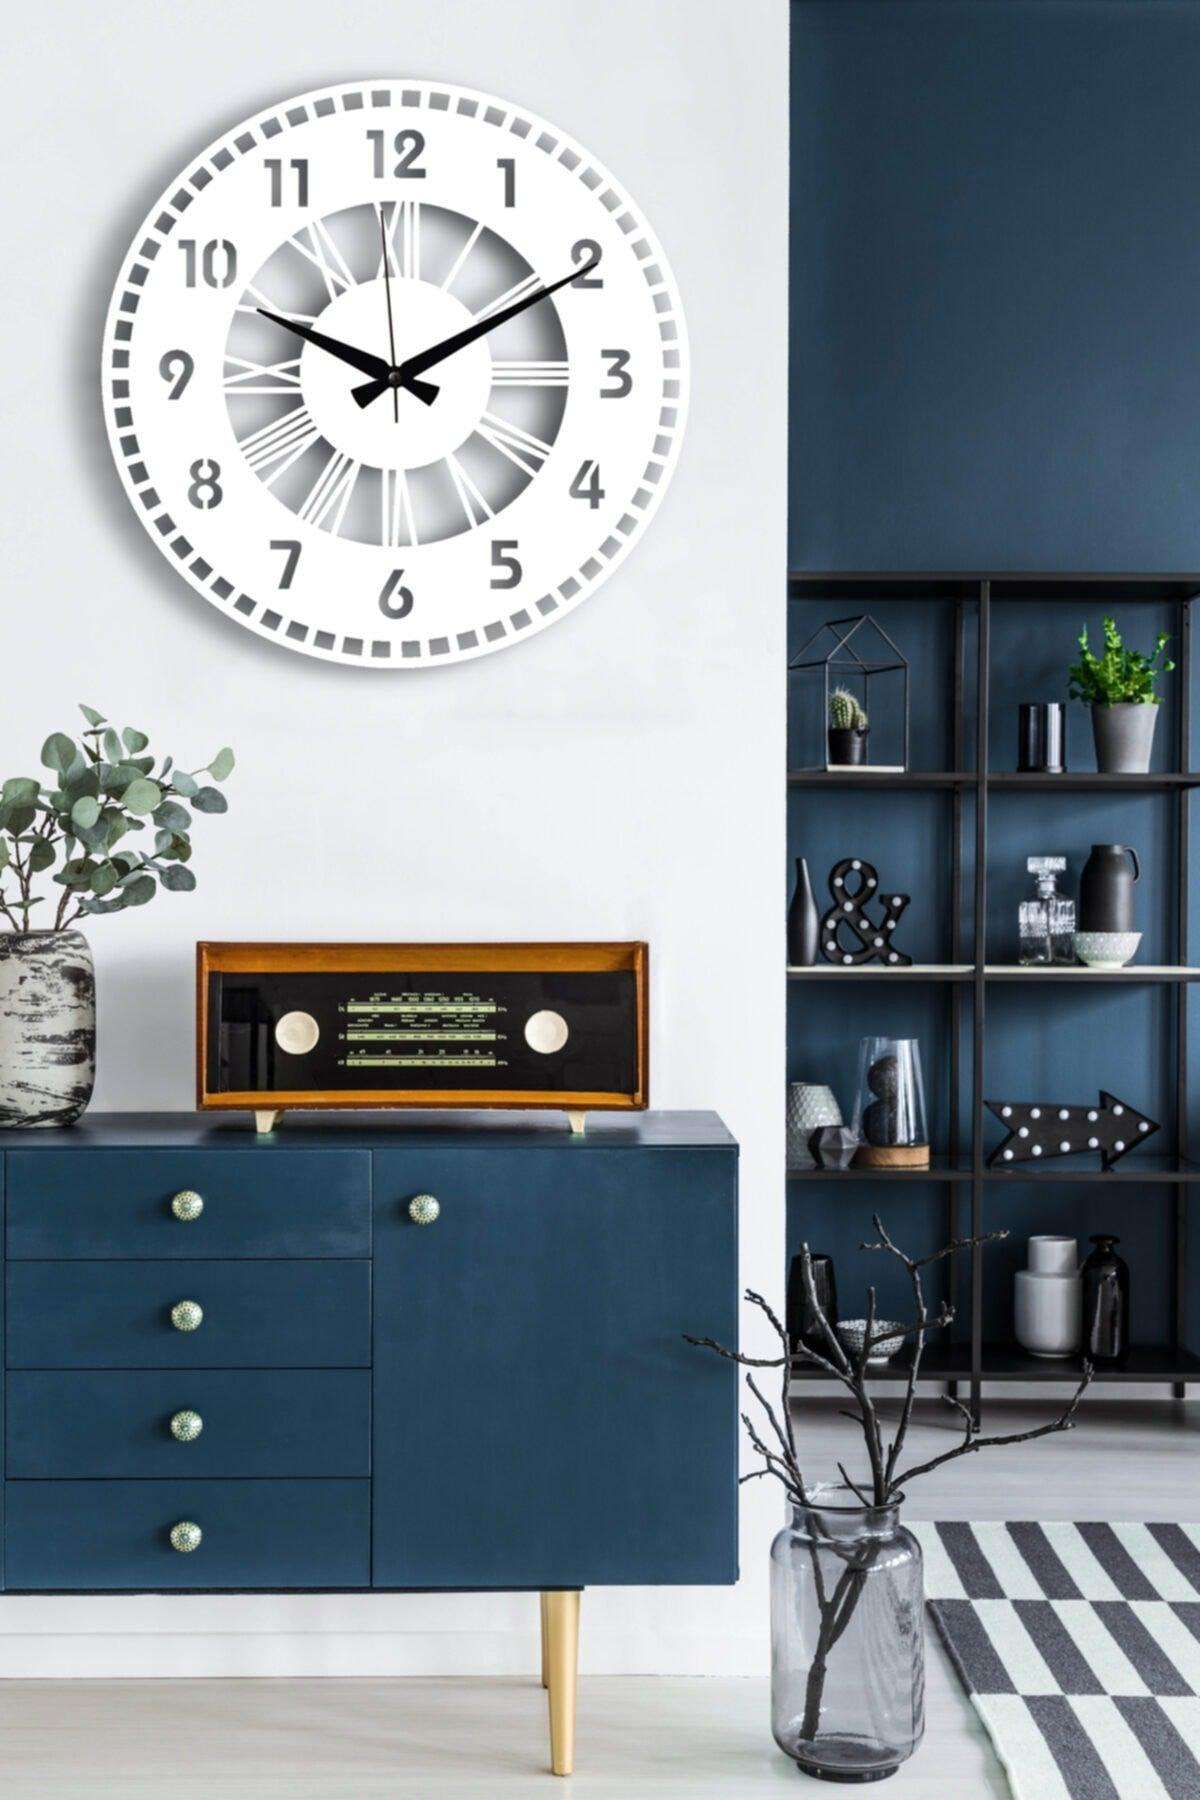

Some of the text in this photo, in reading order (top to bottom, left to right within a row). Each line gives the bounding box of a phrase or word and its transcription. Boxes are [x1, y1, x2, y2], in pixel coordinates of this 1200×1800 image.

[367, 129, 426, 179] 12
[264, 159, 308, 207] 11
[497, 158, 515, 208] 1
[178, 239, 237, 288] 10
[288, 219, 357, 301] XI
[373, 201, 420, 279] XII
[570, 239, 603, 289] 2
[159, 349, 194, 400] 9
[223, 356, 302, 395] IX
[491, 361, 569, 386] III
[600, 349, 632, 398] 3
[188, 459, 223, 509] 8
[569, 460, 605, 509] 4
[270, 540, 302, 589] 7
[490, 540, 522, 589] 5
[379, 569, 414, 619] 6
[820, 858, 912, 966] &
